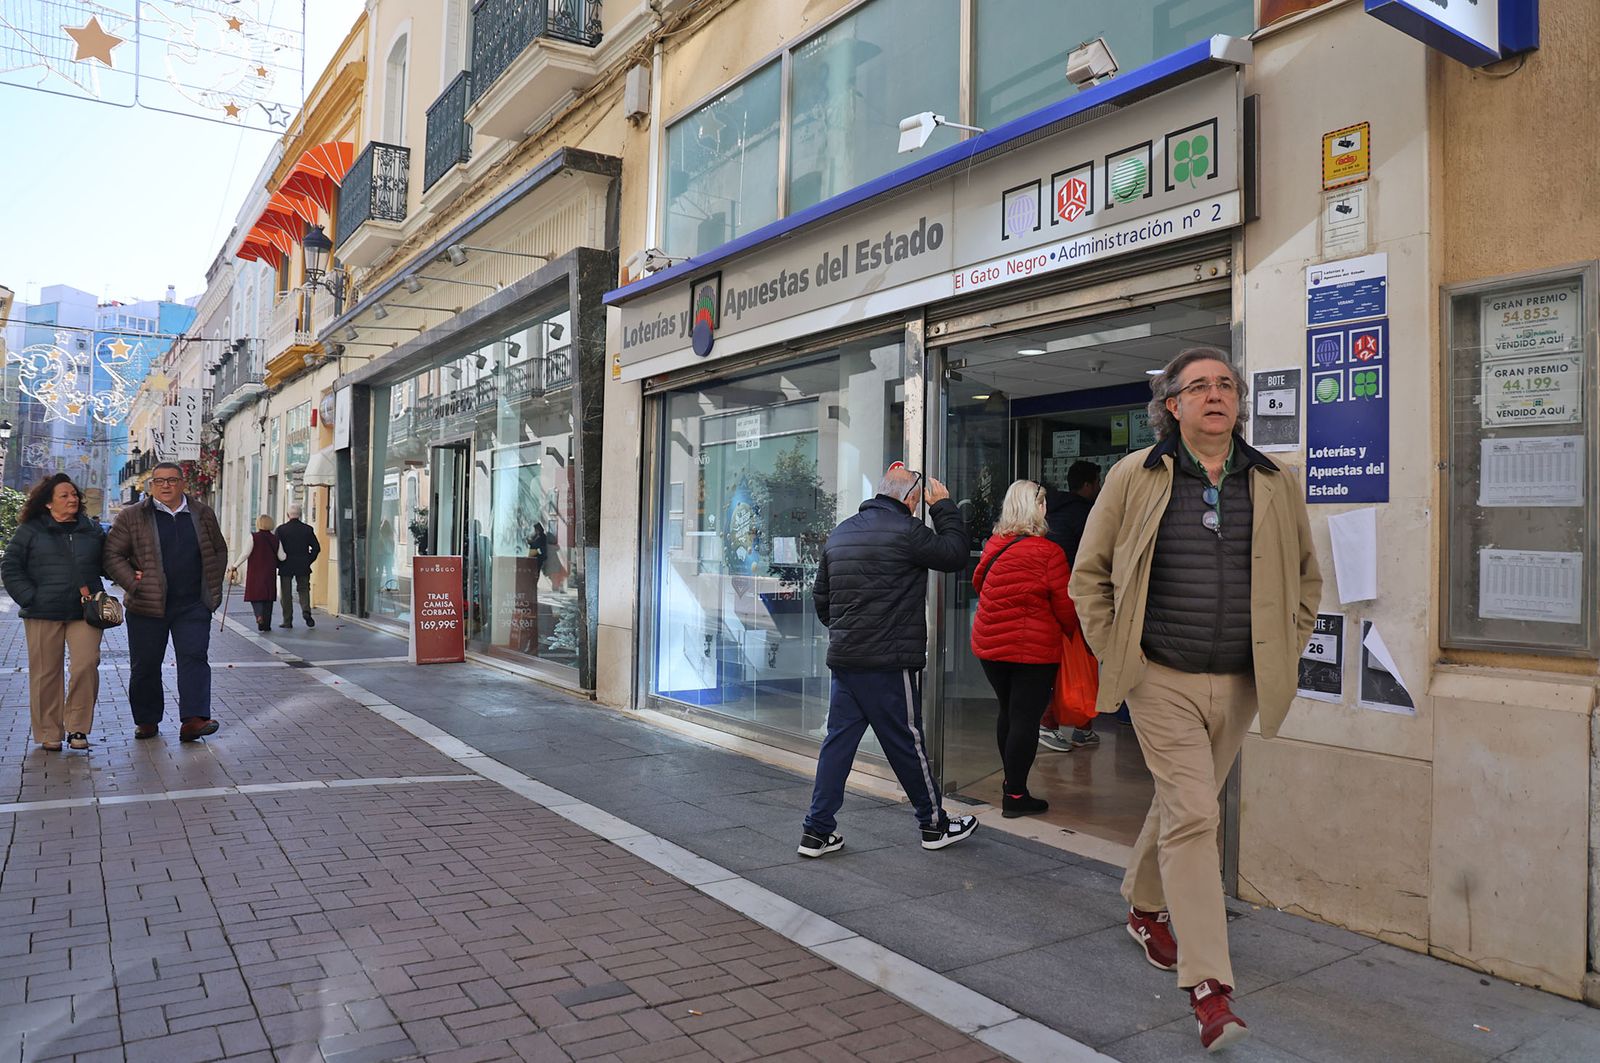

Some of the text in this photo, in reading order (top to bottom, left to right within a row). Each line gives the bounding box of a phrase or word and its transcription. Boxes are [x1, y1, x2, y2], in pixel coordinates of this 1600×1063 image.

[954, 203, 1222, 289] El Gato Negro Administración nº 2
[623, 217, 944, 349] Loterías y Apuestas del Estado
[1493, 292, 1568, 311] GRAN PREMIO
[1502, 306, 1550, 324] 54.853
[1495, 338, 1537, 350] VENDIDO
[1539, 333, 1564, 345] AQUÍ
[1494, 364, 1569, 378] GRAN PREMIO
[1268, 375, 1286, 386] BOTE
[1503, 377, 1552, 391] 44.199
[1269, 399, 1283, 410] 8,9
[1496, 405, 1565, 418] VENDIDO AQUÍ
[186, 395, 196, 441] NOVIAS
[170, 412, 179, 453] NOVIAS
[1309, 446, 1366, 459] Loterías y
[1309, 463, 1384, 479] Apuestas del
[1309, 483, 1348, 496] Estado
[421, 608, 456, 616] CORBATA
[1308, 643, 1324, 655] 26
